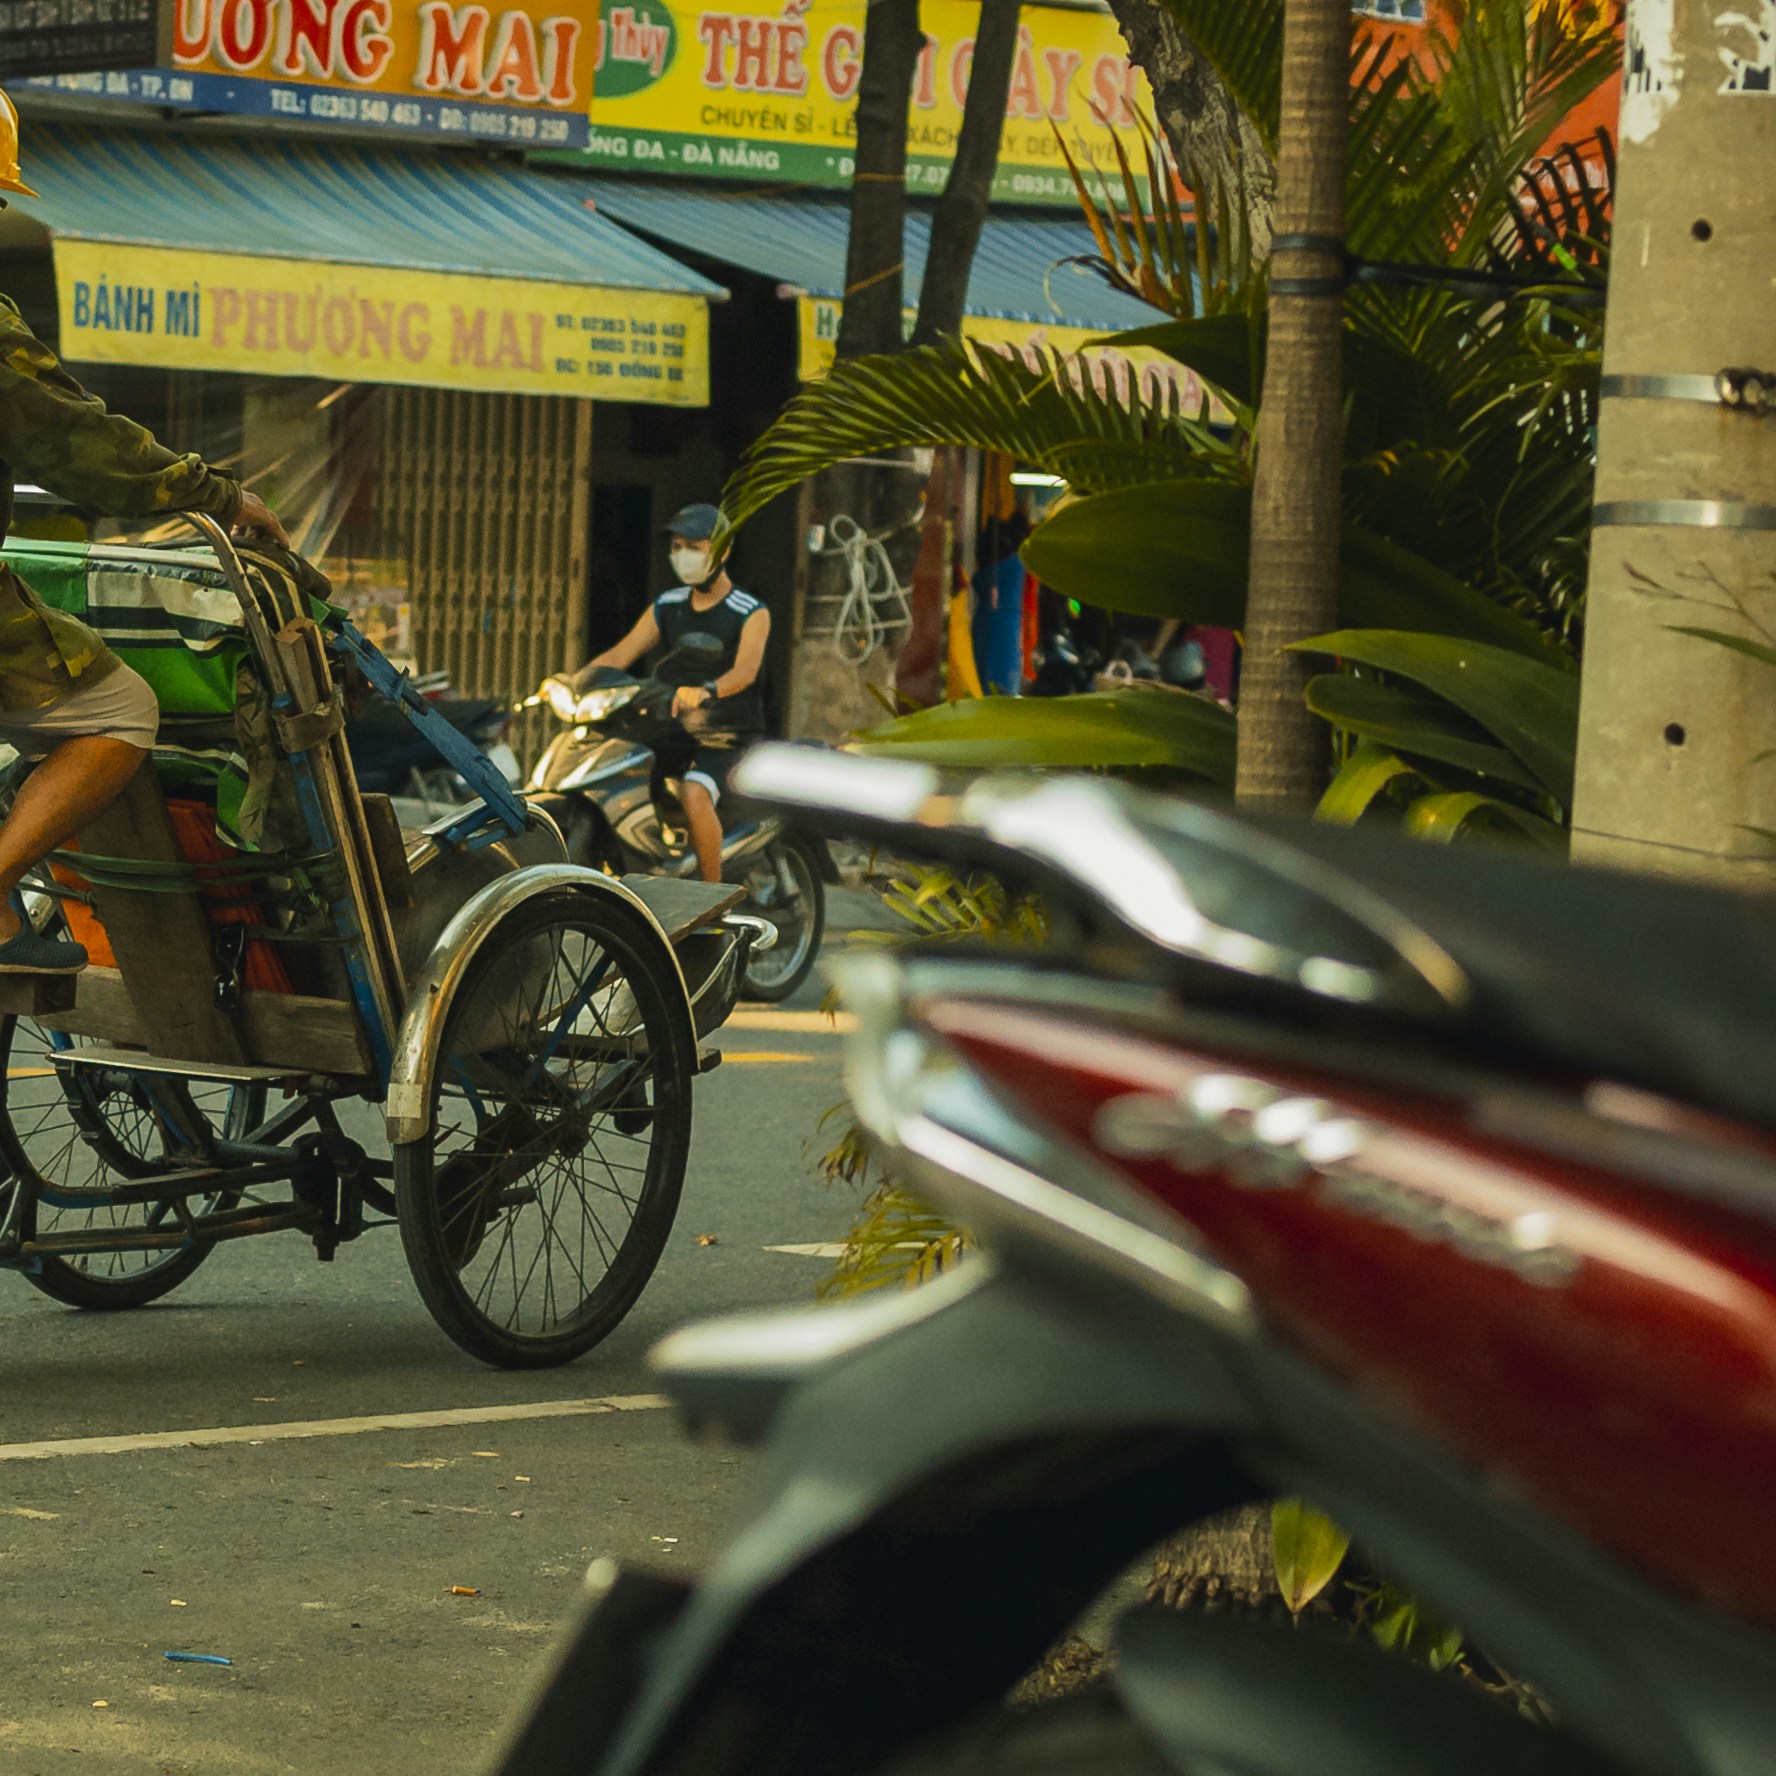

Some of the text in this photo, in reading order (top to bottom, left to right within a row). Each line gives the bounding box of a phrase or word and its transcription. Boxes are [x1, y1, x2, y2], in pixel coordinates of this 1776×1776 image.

[416, 0, 583, 106] MAI
[74, 273, 154, 334] BÁNH
[209, 283, 432, 364] PHƯƠNG
[448, 303, 545, 372] MAI
